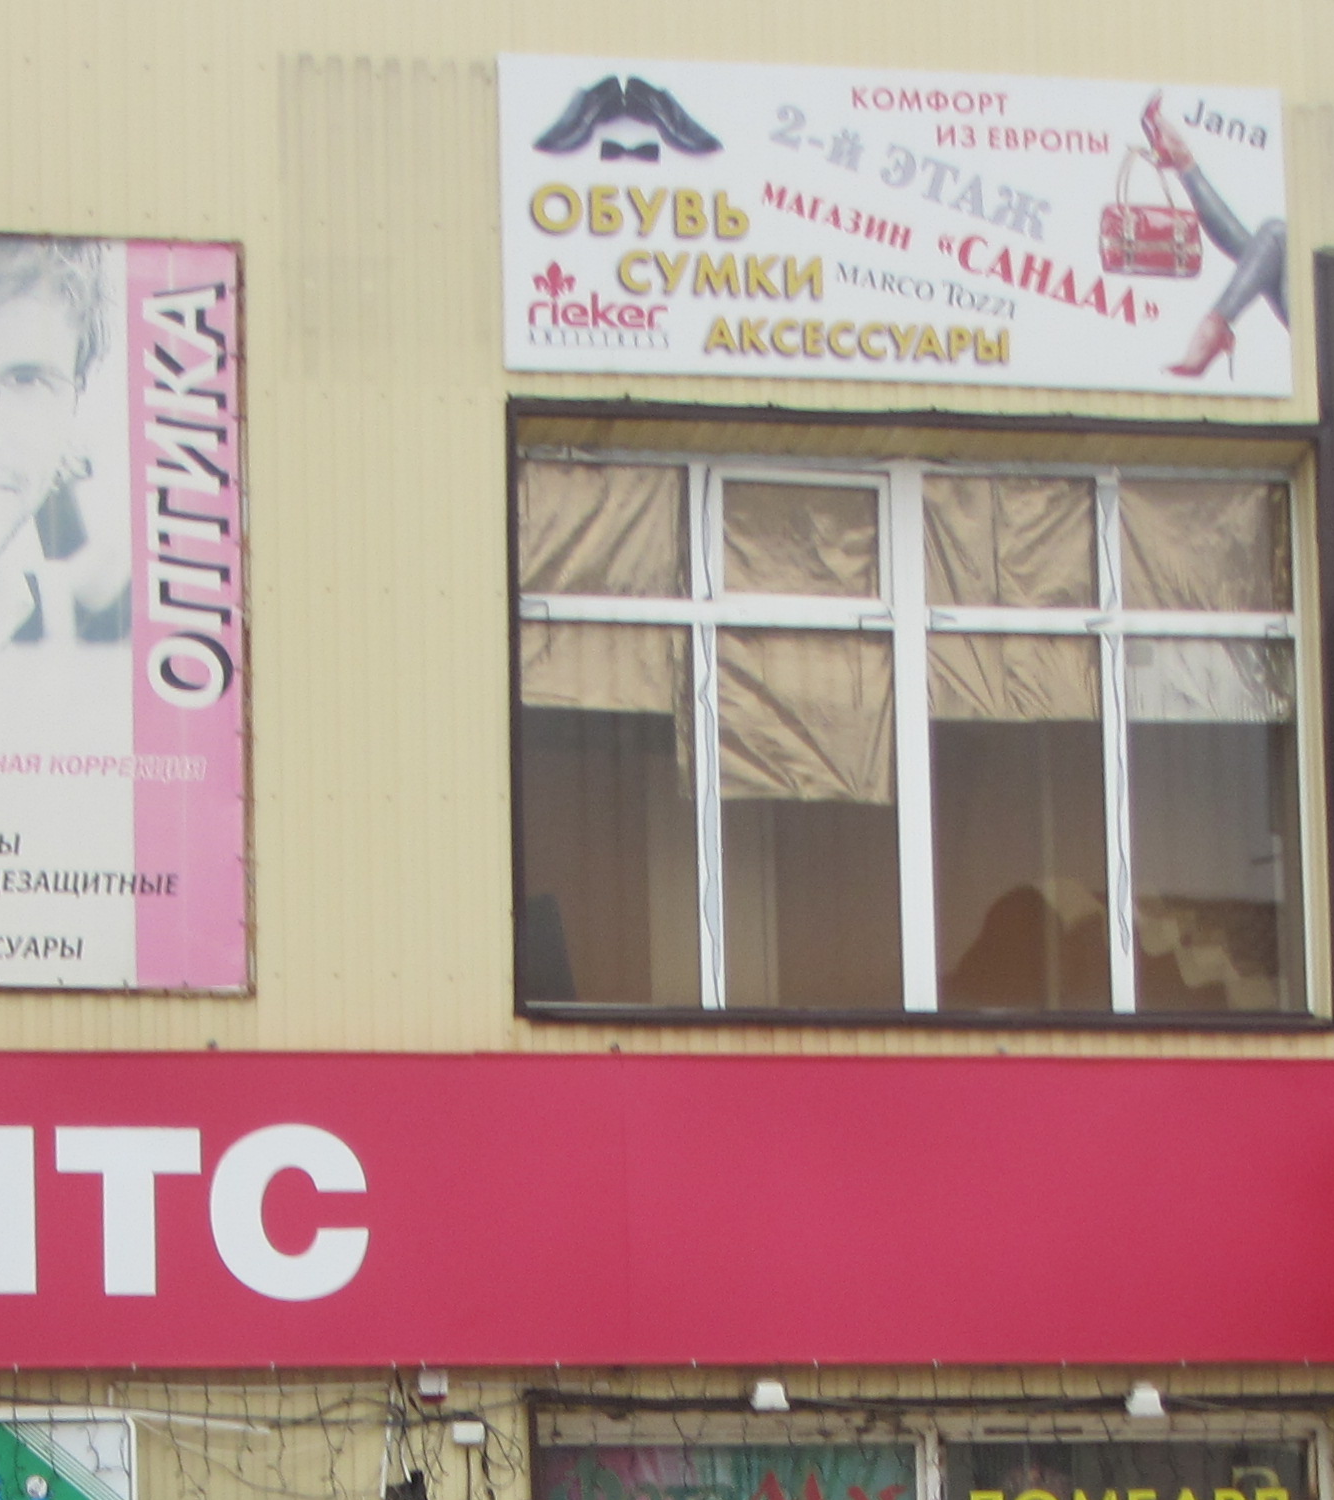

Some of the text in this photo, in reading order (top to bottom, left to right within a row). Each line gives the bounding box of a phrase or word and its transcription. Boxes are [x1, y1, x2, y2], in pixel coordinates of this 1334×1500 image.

[850, 86, 1009, 116] КОМФОРТ
[1183, 100, 1267, 150] Jana
[935, 125, 1110, 154] ИЗ ЕВРОПЫ
[768, 104, 1052, 241] 2-й ЭТАЖ
[530, 183, 750, 241] ОБУВЬ
[762, 180, 912, 251] МАГАЗИН
[618, 249, 824, 301] СУМКИ
[836, 262, 935, 301] MARCO
[528, 293, 667, 330] rieker
[705, 316, 1011, 366] АКСЕССУАРЫ
[142, 282, 233, 711] ОПТИКА
[49, 755, 208, 782] КОРРЕКЦИЯ
